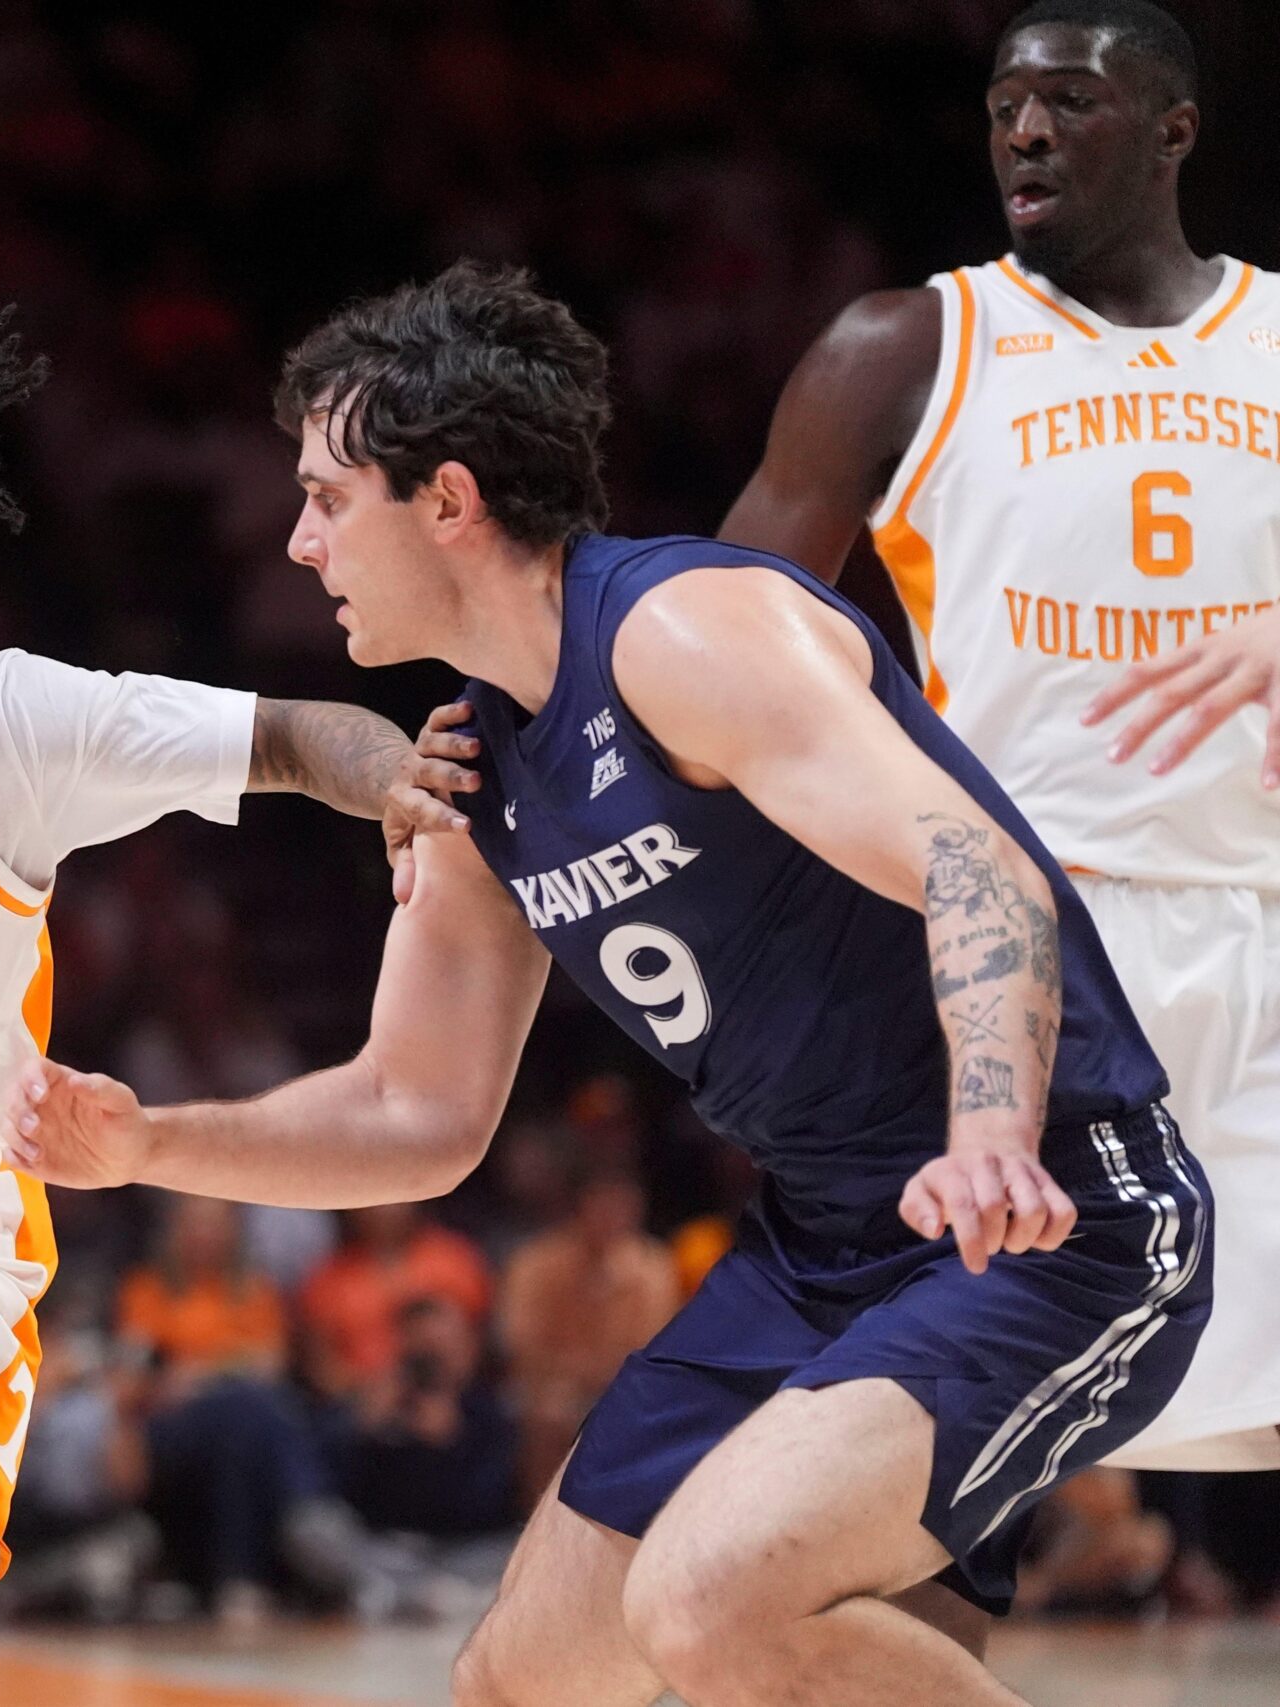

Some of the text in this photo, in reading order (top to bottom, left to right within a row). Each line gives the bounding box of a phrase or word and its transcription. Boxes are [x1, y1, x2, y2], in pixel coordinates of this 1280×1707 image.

[1131, 471, 1193, 577] 6
[510, 823, 702, 929] XAVIER
[600, 922, 712, 1050] 9
